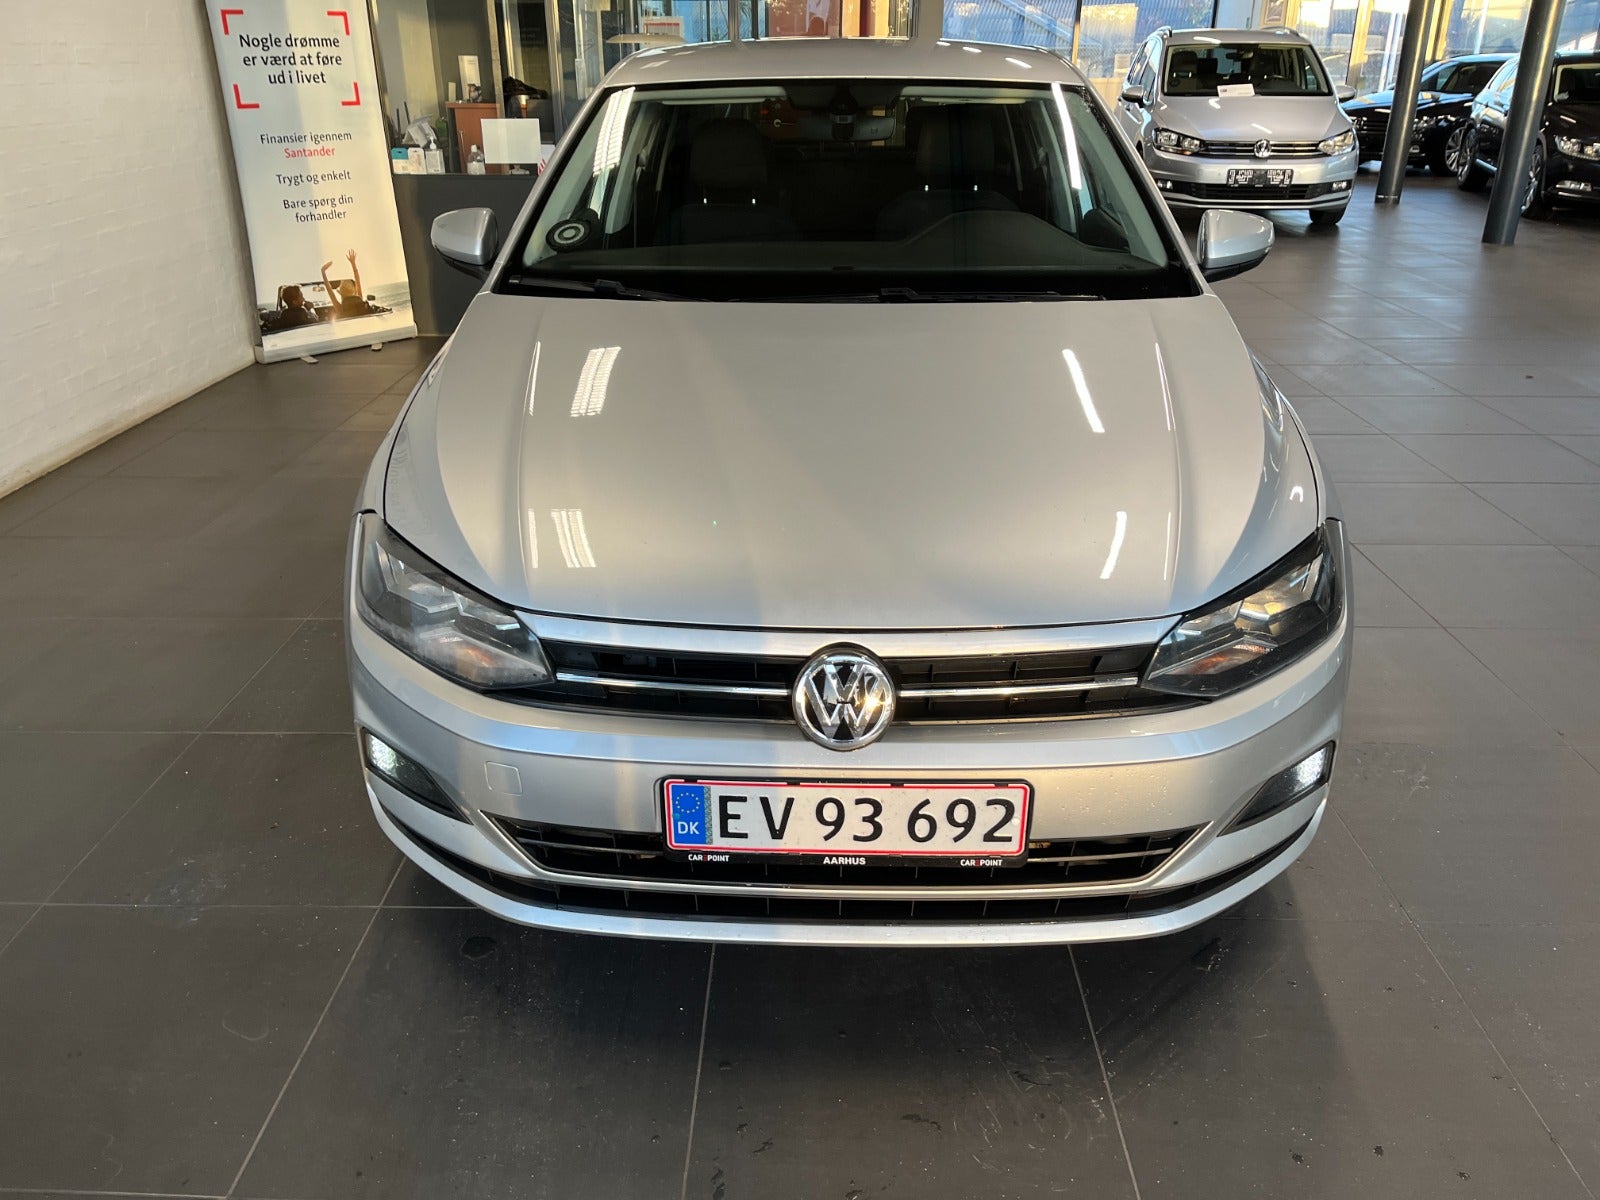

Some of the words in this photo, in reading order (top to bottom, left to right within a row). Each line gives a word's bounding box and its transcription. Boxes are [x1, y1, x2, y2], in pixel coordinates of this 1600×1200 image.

[239, 33, 282, 51] Nogle
[285, 33, 340, 48] drømme
[243, 55, 257, 66] er
[261, 52, 297, 66] værd
[299, 53, 314, 66] at
[316, 51, 342, 66] føre
[268, 71, 286, 84] ud
[288, 70, 293, 84] i
[295, 70, 327, 84] livet
[260, 133, 307, 145] Finansier
[310, 131, 352, 145] igennem
[284, 146, 336, 158] Santander
[276, 173, 304, 186] Trygt
[306, 175, 319, 184] og
[320, 170, 352, 182] enkelt
[283, 199, 307, 209] Bare
[308, 198, 337, 210] spørg
[338, 195, 354, 205] din
[295, 210, 347, 223] forhandler
[719, 795, 795, 840] EV
[815, 797, 883, 842] 93
[907, 798, 1016, 843] 692
[677, 821, 700, 835] DK
[823, 857, 866, 866] AARHUS
